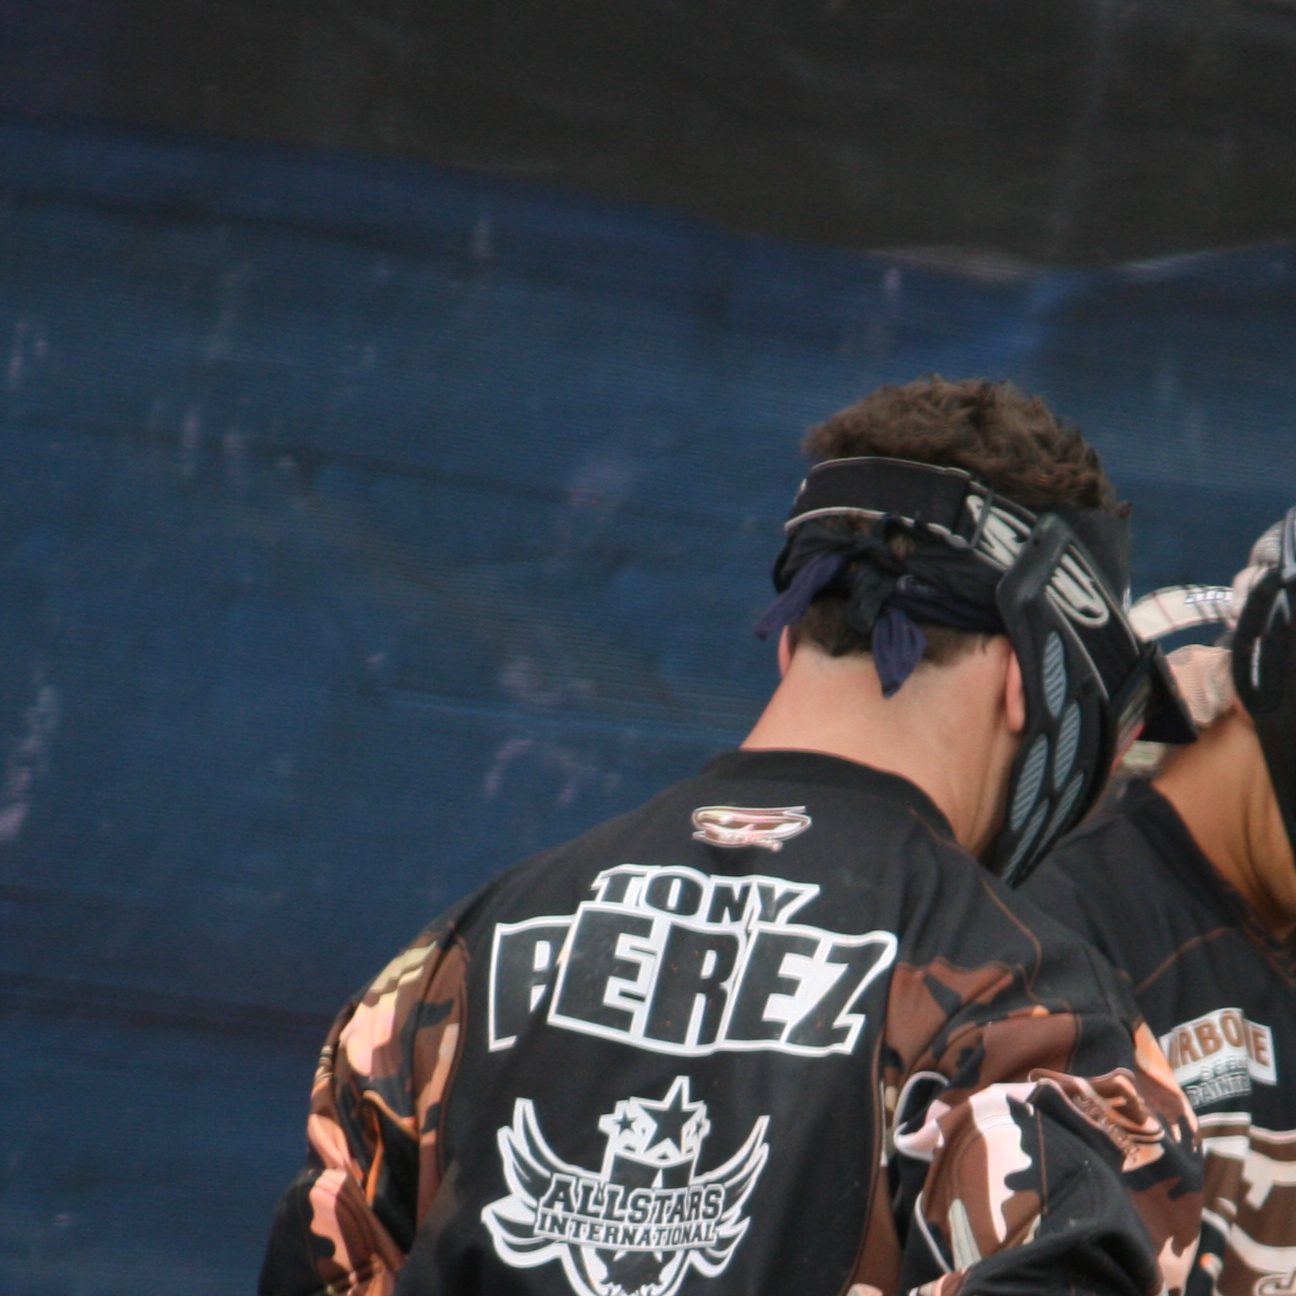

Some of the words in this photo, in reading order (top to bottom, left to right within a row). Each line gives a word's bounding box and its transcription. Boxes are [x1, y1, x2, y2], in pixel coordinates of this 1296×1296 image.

[594, 866, 816, 925] TONY
[491, 905, 895, 1055] PEREZ
[541, 1175, 724, 1224] ALLSTARS
[536, 1212, 717, 1248] INTERNATIONAL
